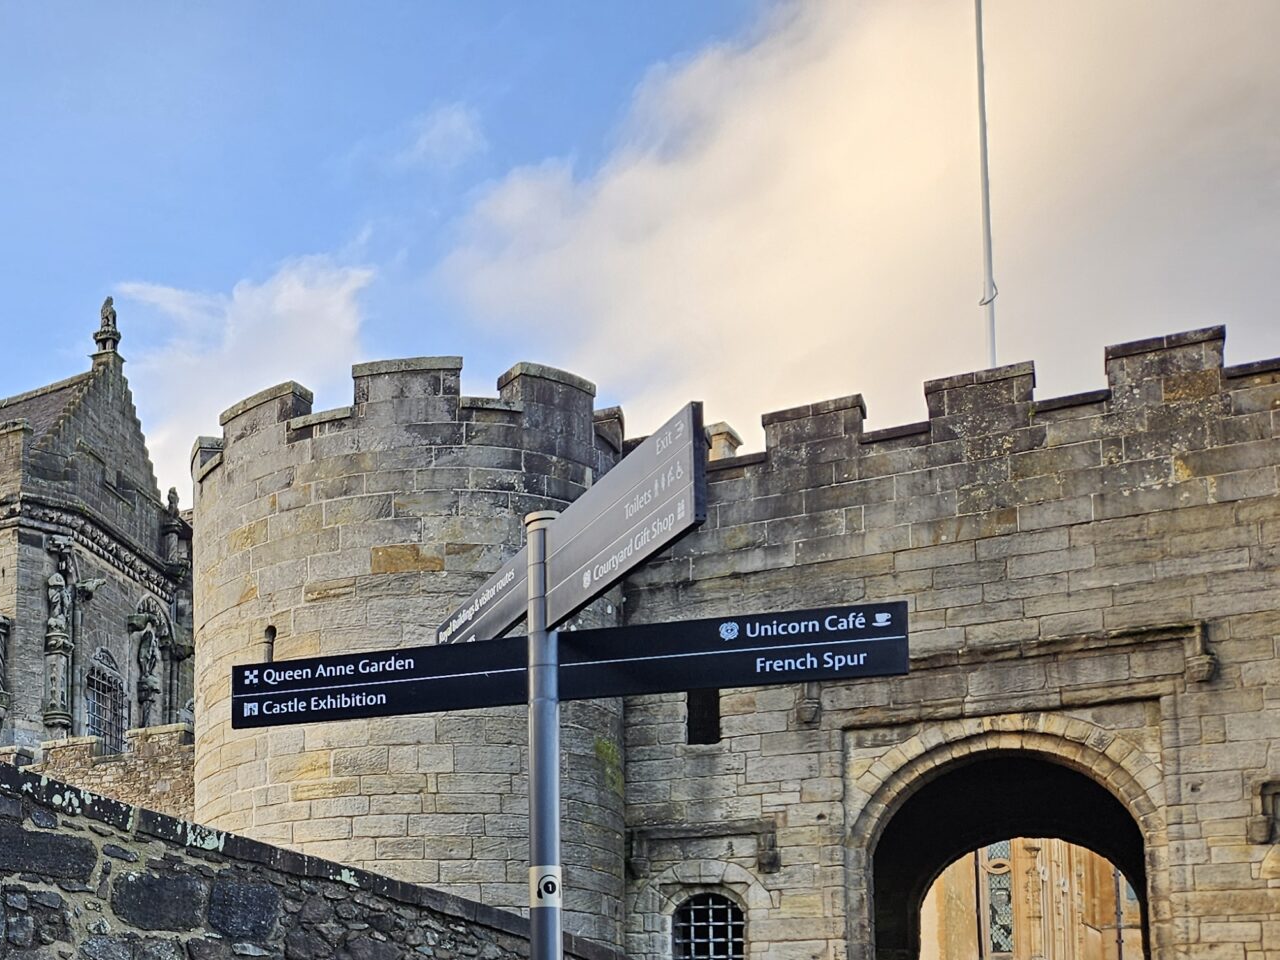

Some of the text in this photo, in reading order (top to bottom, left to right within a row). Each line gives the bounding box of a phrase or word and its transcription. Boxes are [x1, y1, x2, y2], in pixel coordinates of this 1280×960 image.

[655, 434, 673, 456] Exit
[623, 489, 652, 520] Toilets
[593, 513, 675, 581] Courtyard Gift Shop
[474, 598, 480, 611] &
[479, 586, 496, 608] visitor
[496, 568, 515, 593] routes
[746, 612, 866, 638] Unicorn Café
[263, 656, 415, 685] Queen Anne Garden
[756, 651, 867, 673] French Spur
[262, 691, 387, 715] Castle Exhibition
[547, 884, 553, 892] 1
